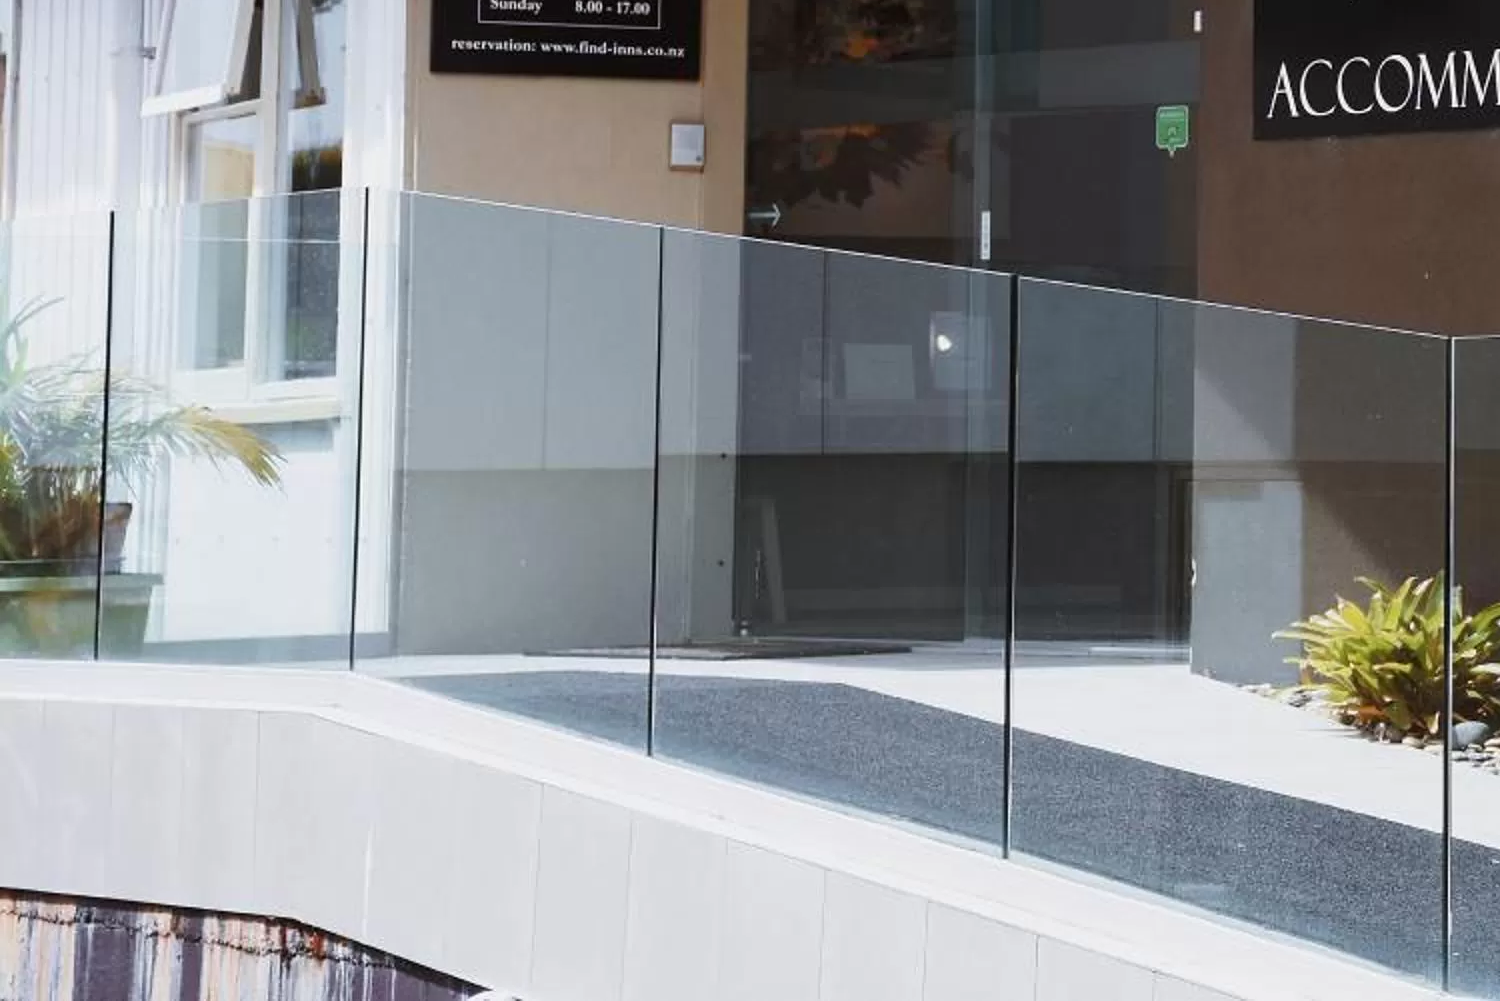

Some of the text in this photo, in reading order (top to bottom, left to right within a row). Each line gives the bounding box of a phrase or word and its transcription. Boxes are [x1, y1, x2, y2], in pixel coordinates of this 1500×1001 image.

[575, 0, 603, 13] 8.00
[616, 1, 651, 15] 17.00
[451, 38, 685, 58] reservation: www.find-inns.co.nz
